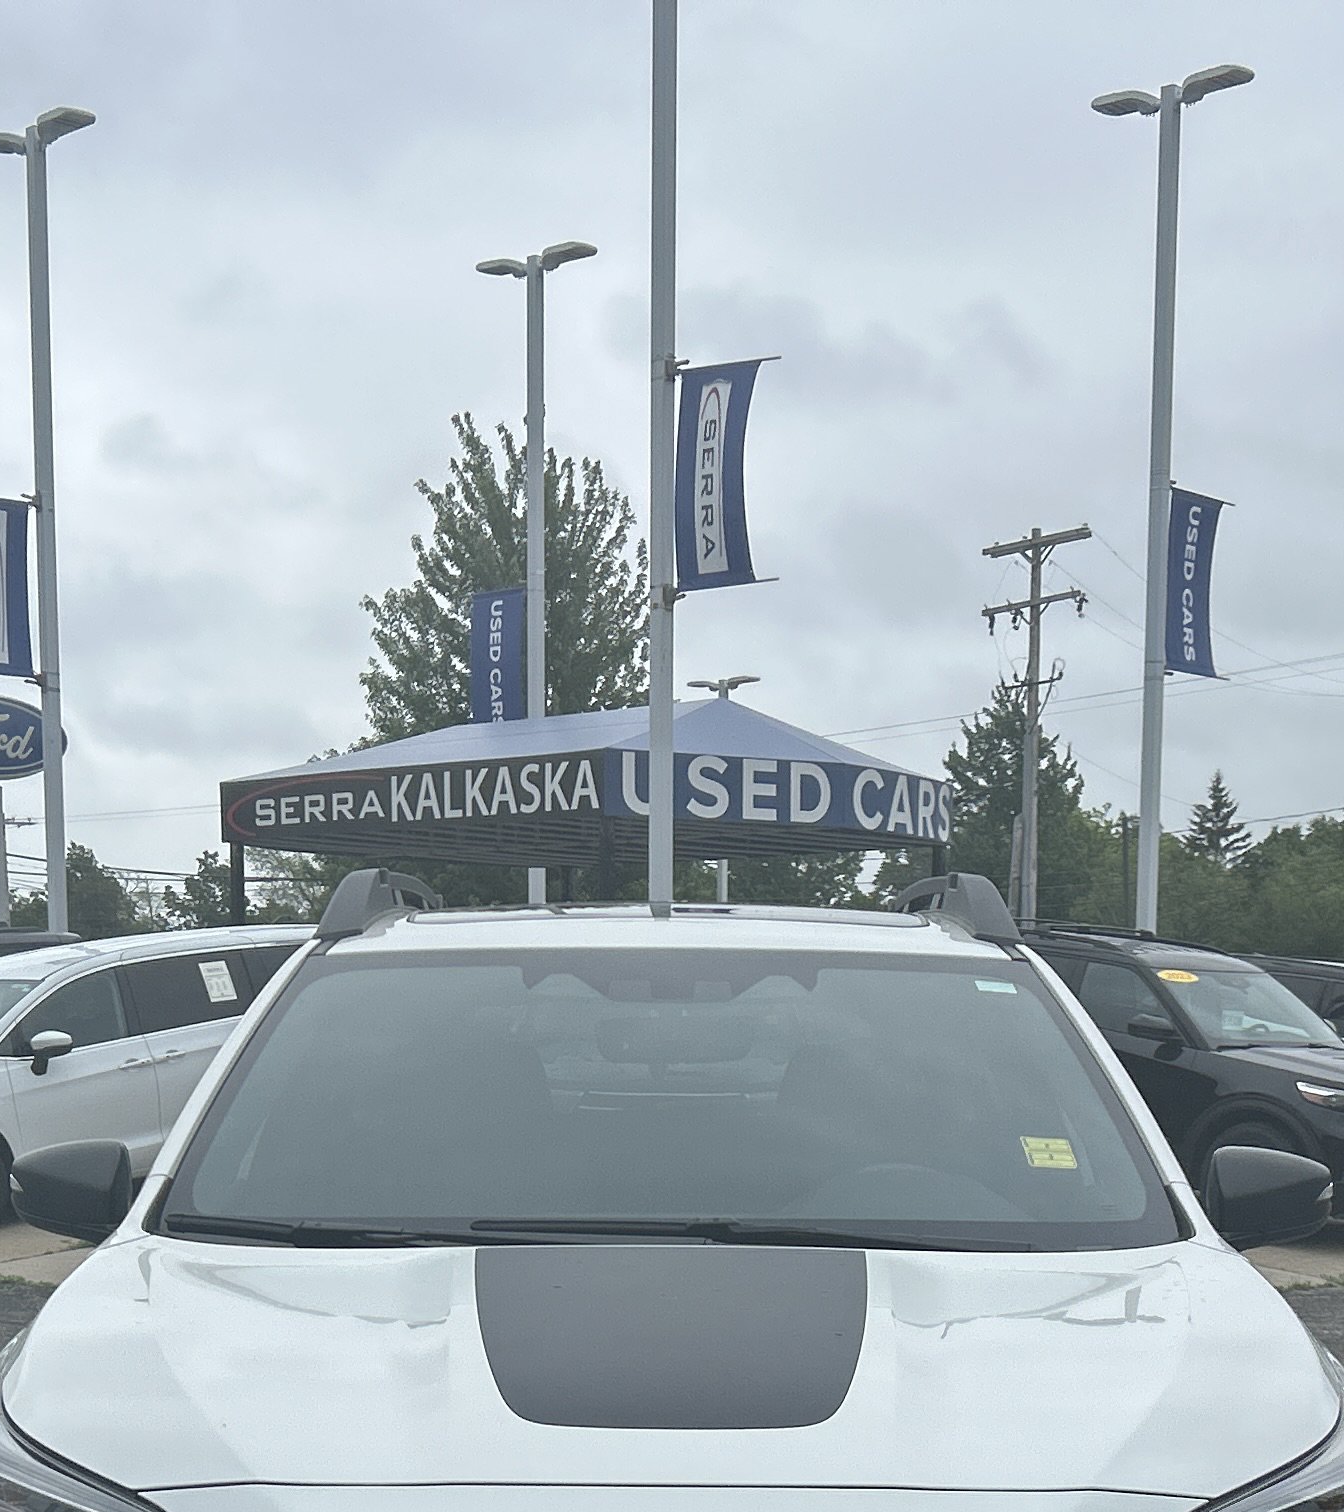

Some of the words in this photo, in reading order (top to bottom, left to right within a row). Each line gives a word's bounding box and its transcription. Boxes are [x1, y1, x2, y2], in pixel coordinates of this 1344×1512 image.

[701, 419, 717, 560] SERRA
[1183, 505, 1202, 581] USED
[489, 600, 503, 663] USED
[1182, 588, 1196, 662] CARS
[255, 789, 386, 828] SERRA
[391, 759, 600, 823] KALKASKA
[621, 751, 832, 824] USED
[853, 768, 952, 843] CARS
